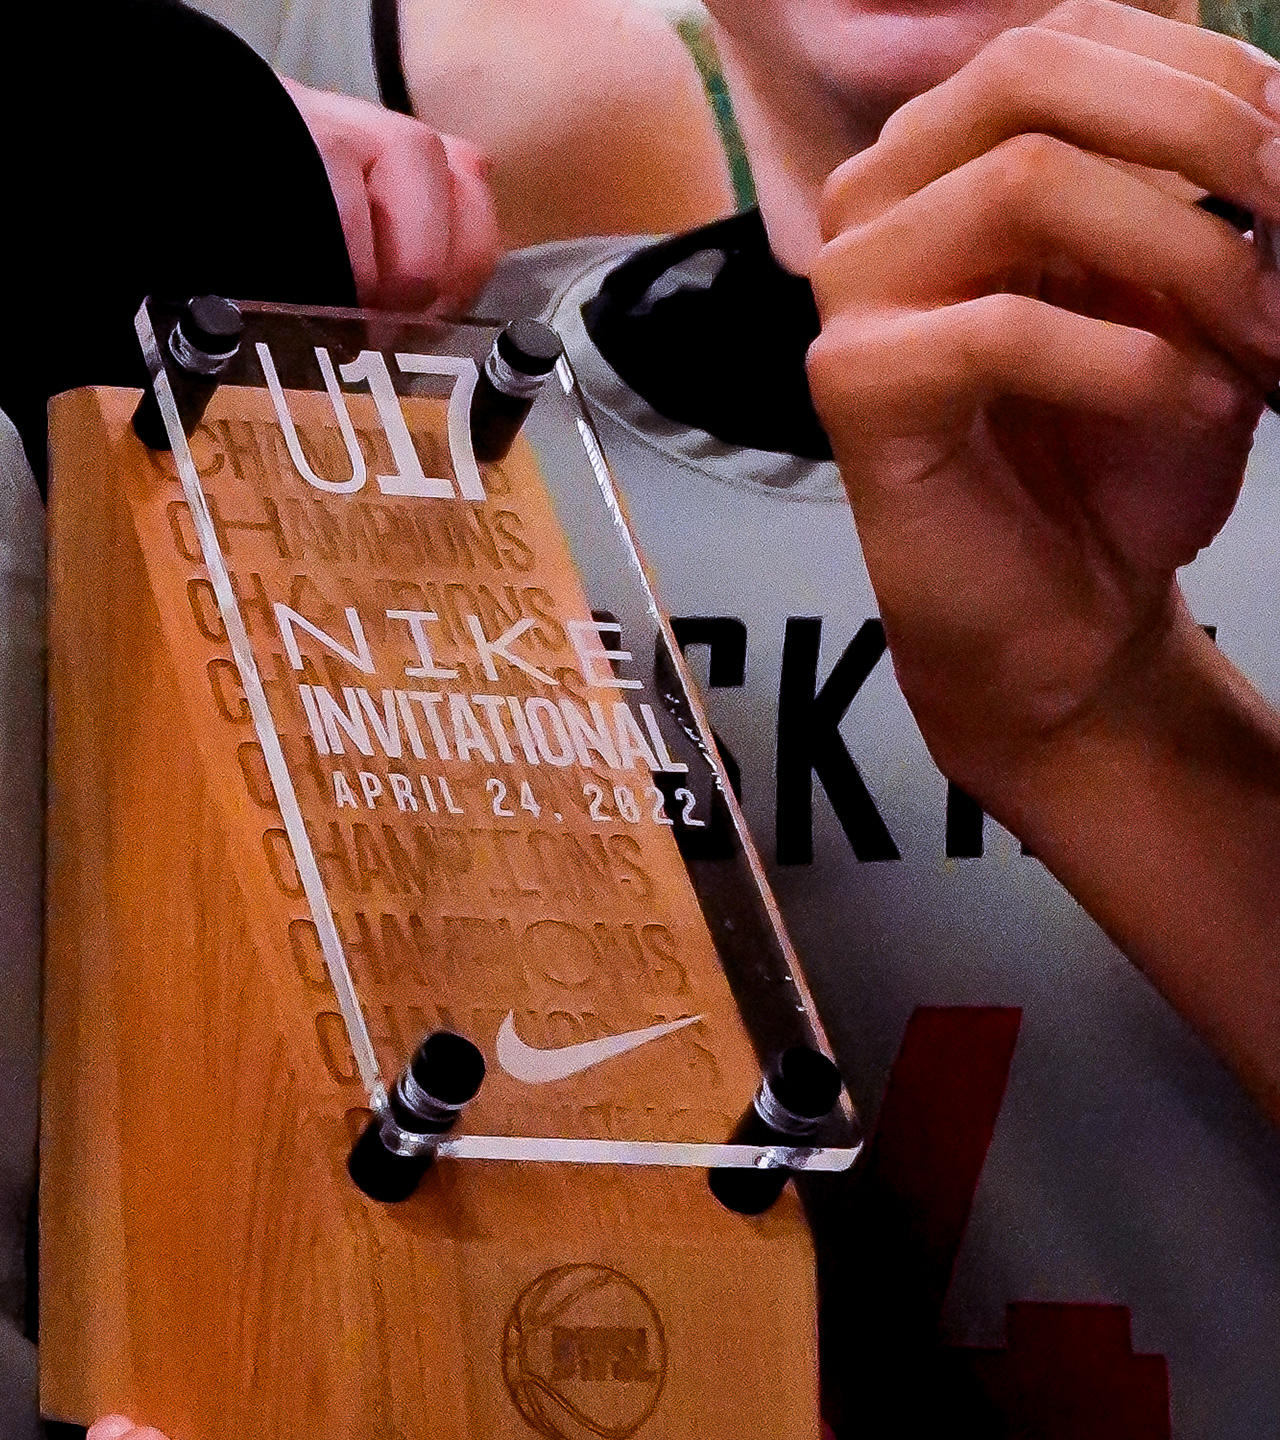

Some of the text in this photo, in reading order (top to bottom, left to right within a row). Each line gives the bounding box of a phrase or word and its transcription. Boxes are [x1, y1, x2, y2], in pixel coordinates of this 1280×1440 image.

[254, 340, 487, 502] U17
[273, 602, 644, 691] NIKE
[297, 683, 689, 774] INVITATIONAL
[331, 770, 465, 815] APRIL
[582, 782, 706, 828] 2022
